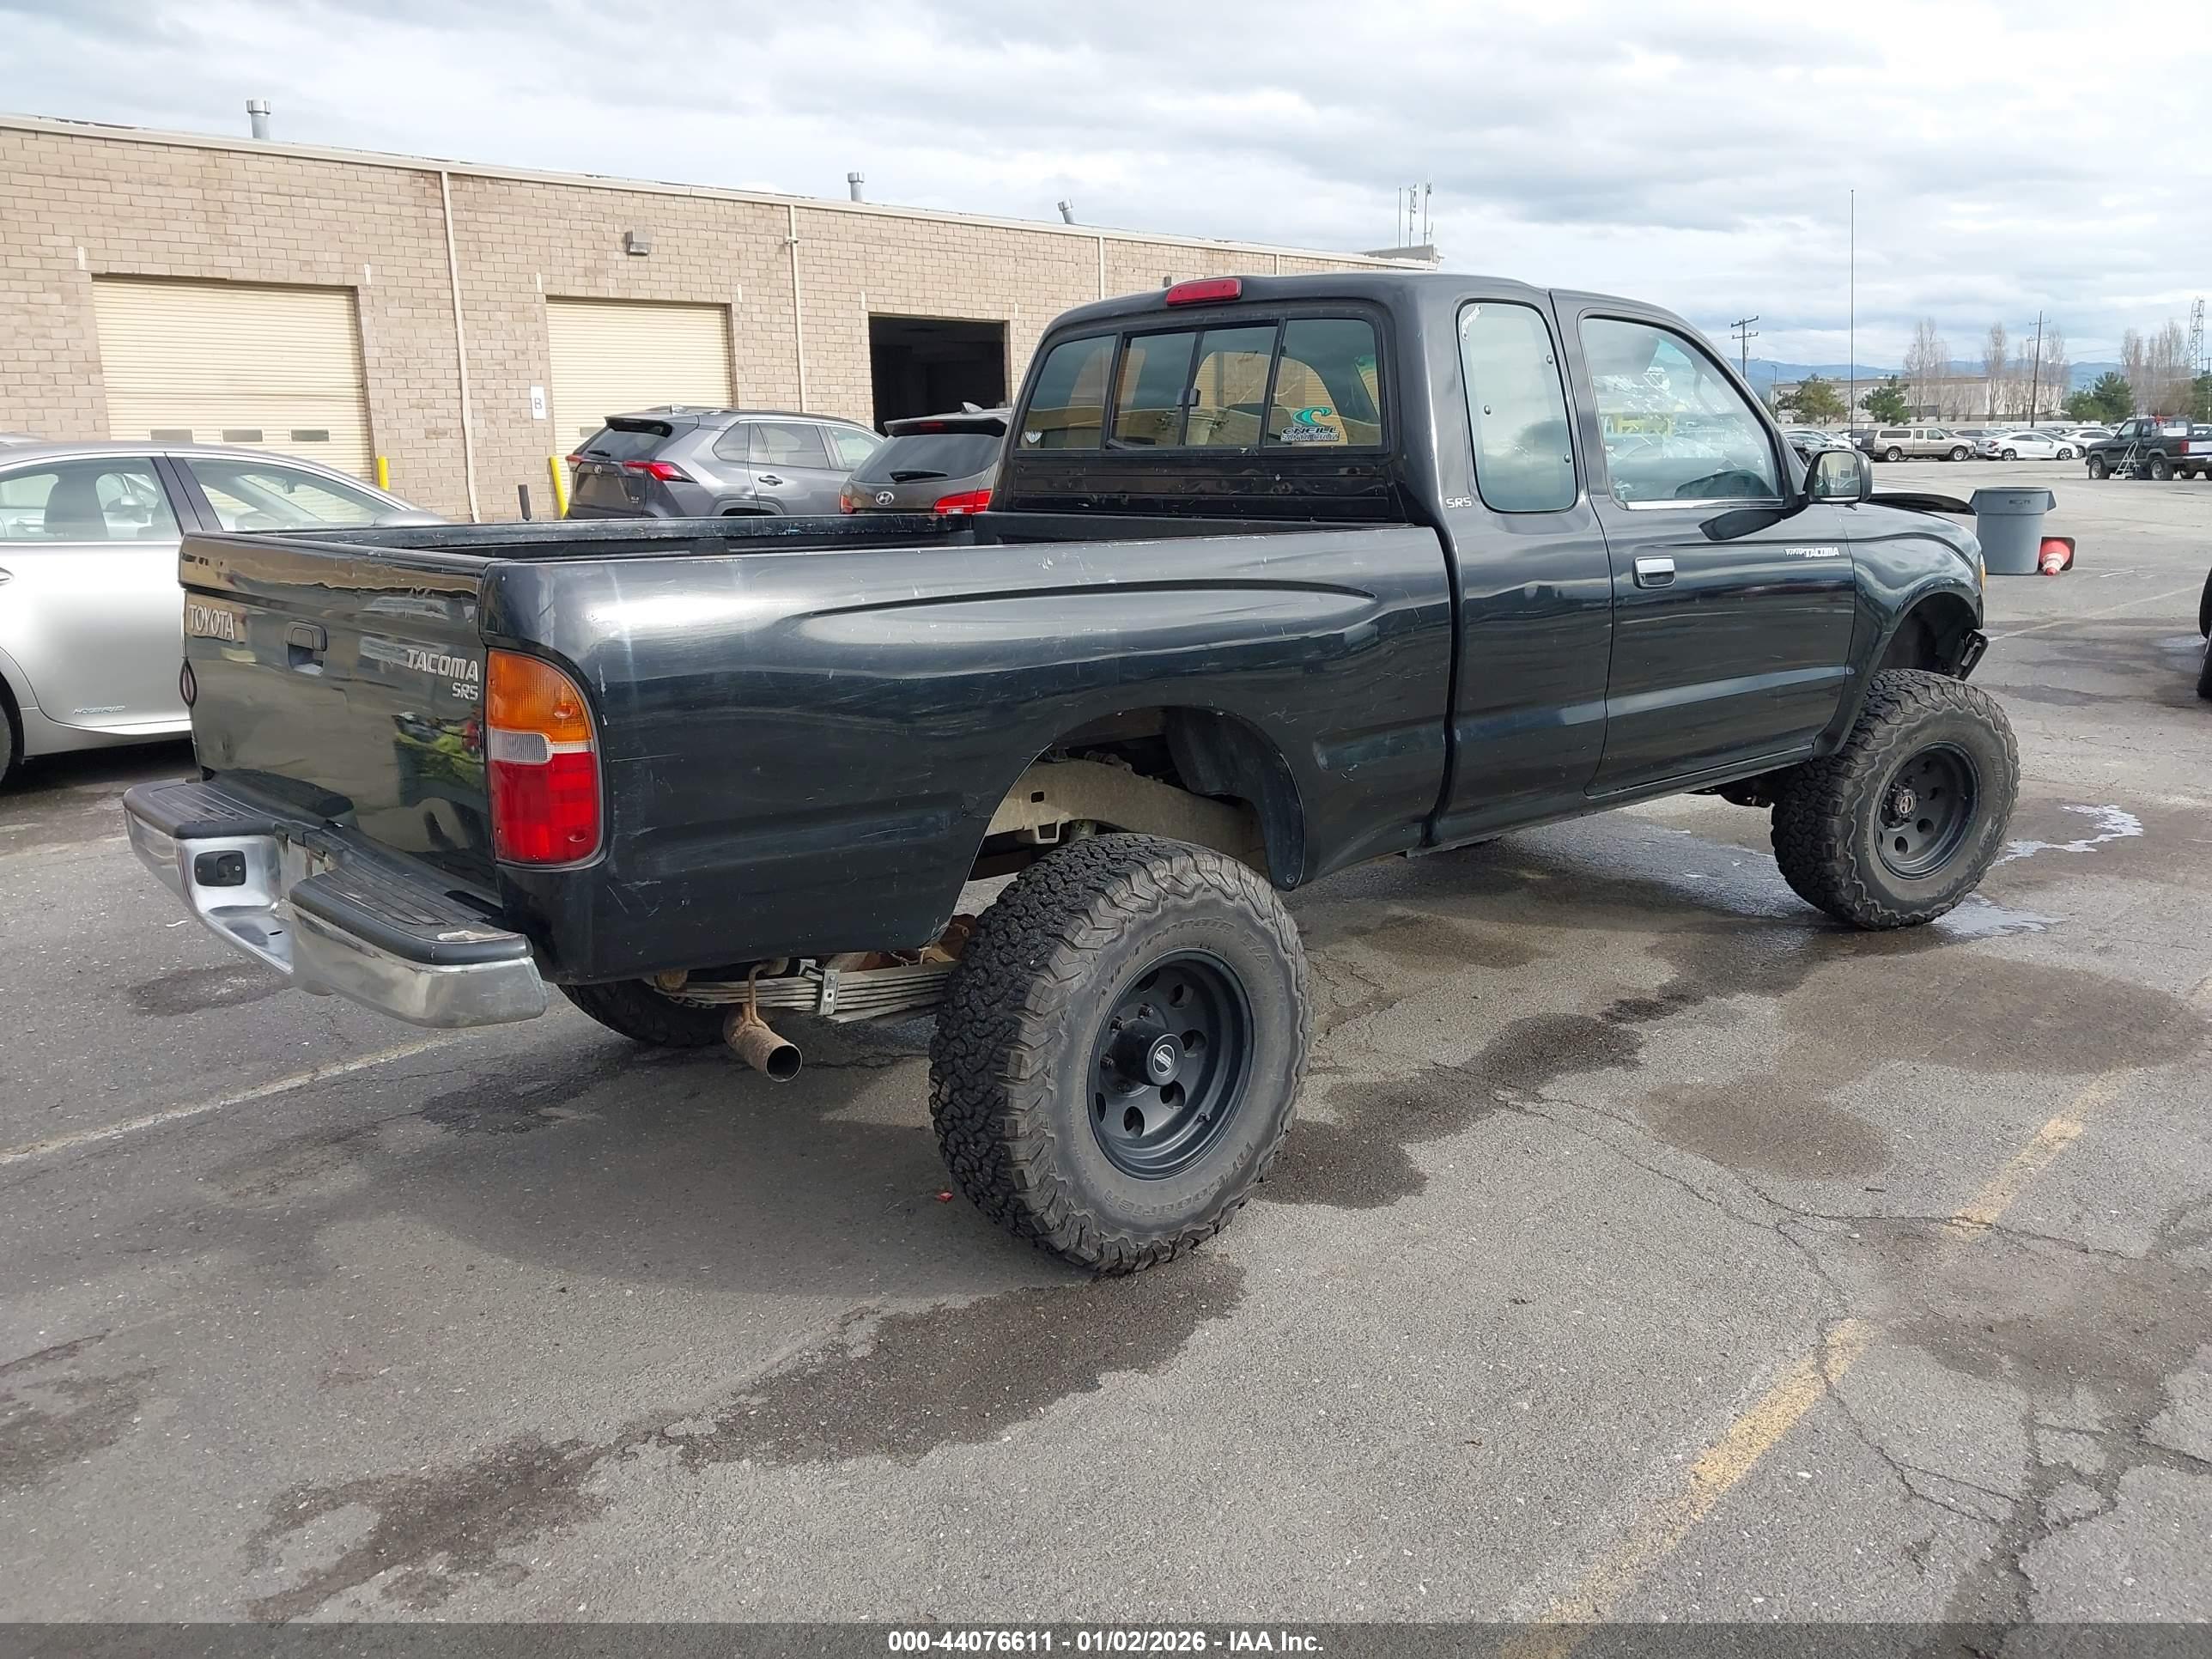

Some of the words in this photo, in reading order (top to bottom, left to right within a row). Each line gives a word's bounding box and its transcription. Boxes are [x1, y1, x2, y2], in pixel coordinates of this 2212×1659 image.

[534, 398, 543, 410] B
[1280, 433, 1311, 441] SANTA
[1313, 433, 1340, 441] CRUZ
[188, 604, 234, 640] TOYOTA
[407, 648, 479, 683] TACOMA
